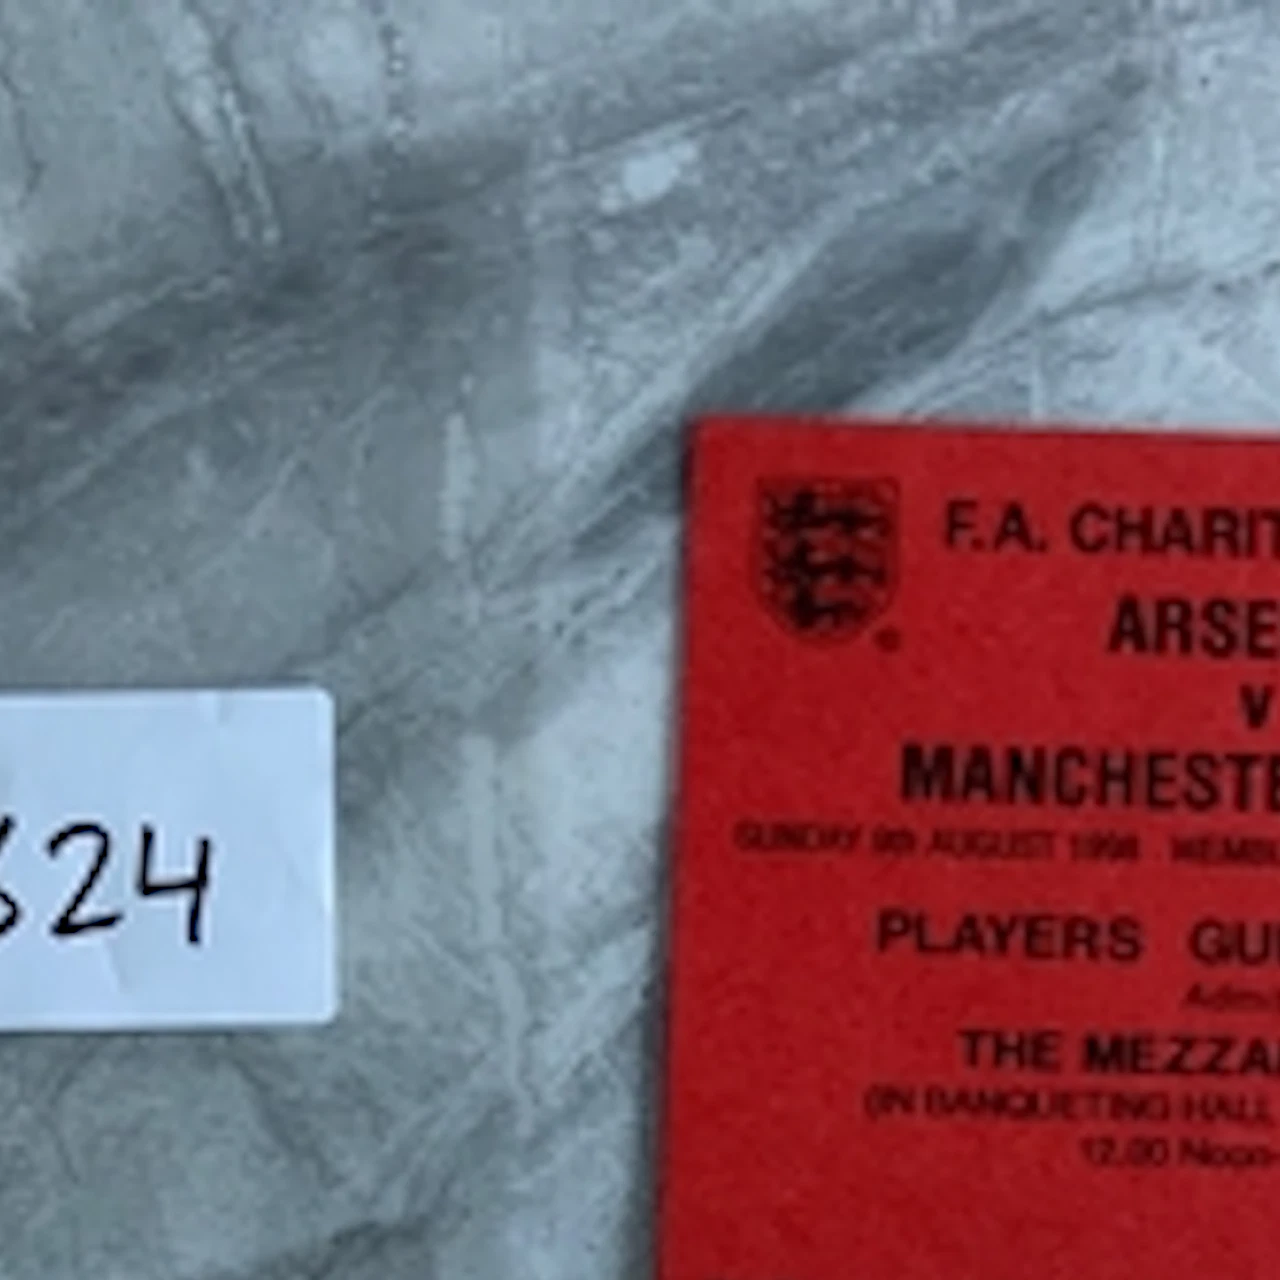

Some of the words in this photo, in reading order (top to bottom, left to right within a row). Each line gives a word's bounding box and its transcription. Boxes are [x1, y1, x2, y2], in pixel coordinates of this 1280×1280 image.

[944, 499, 1048, 553] F.A.
[926, 827, 1057, 861] AUGUST
[876, 907, 1144, 963] PLAYERS
[960, 1028, 1059, 1073] THE
[922, 1086, 1172, 1122] BANQUETING
[1178, 1093, 1271, 1125] HALL
